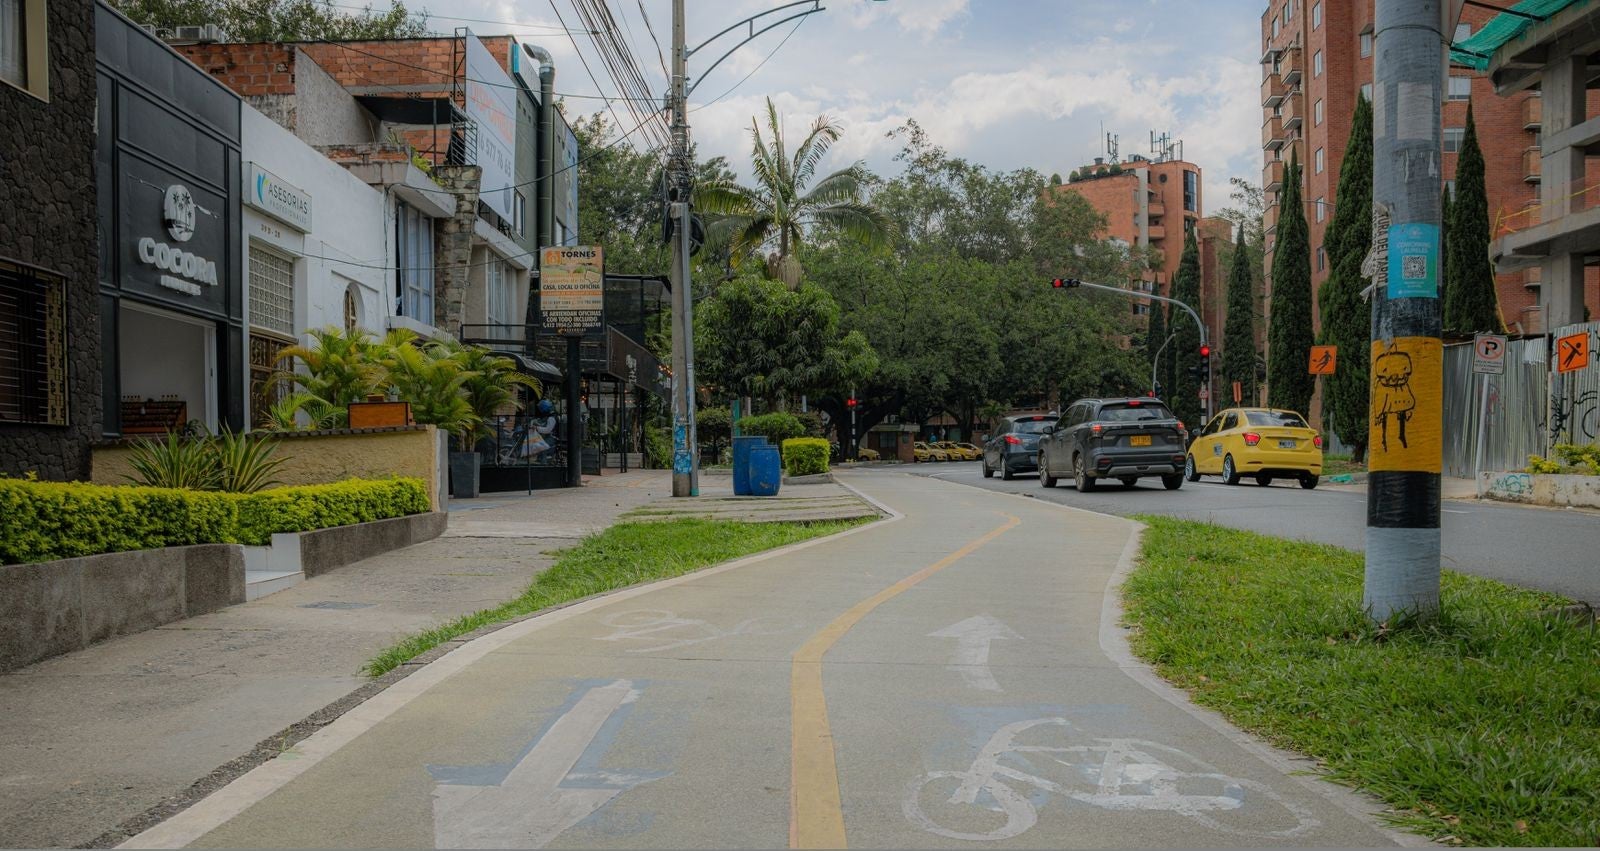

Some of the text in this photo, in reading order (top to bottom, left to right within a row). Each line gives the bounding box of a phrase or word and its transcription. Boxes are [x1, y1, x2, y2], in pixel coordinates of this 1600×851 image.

[268, 183, 308, 214] ASESORIAS
[138, 236, 218, 286] COCORA
[561, 250, 596, 258] TORNES
